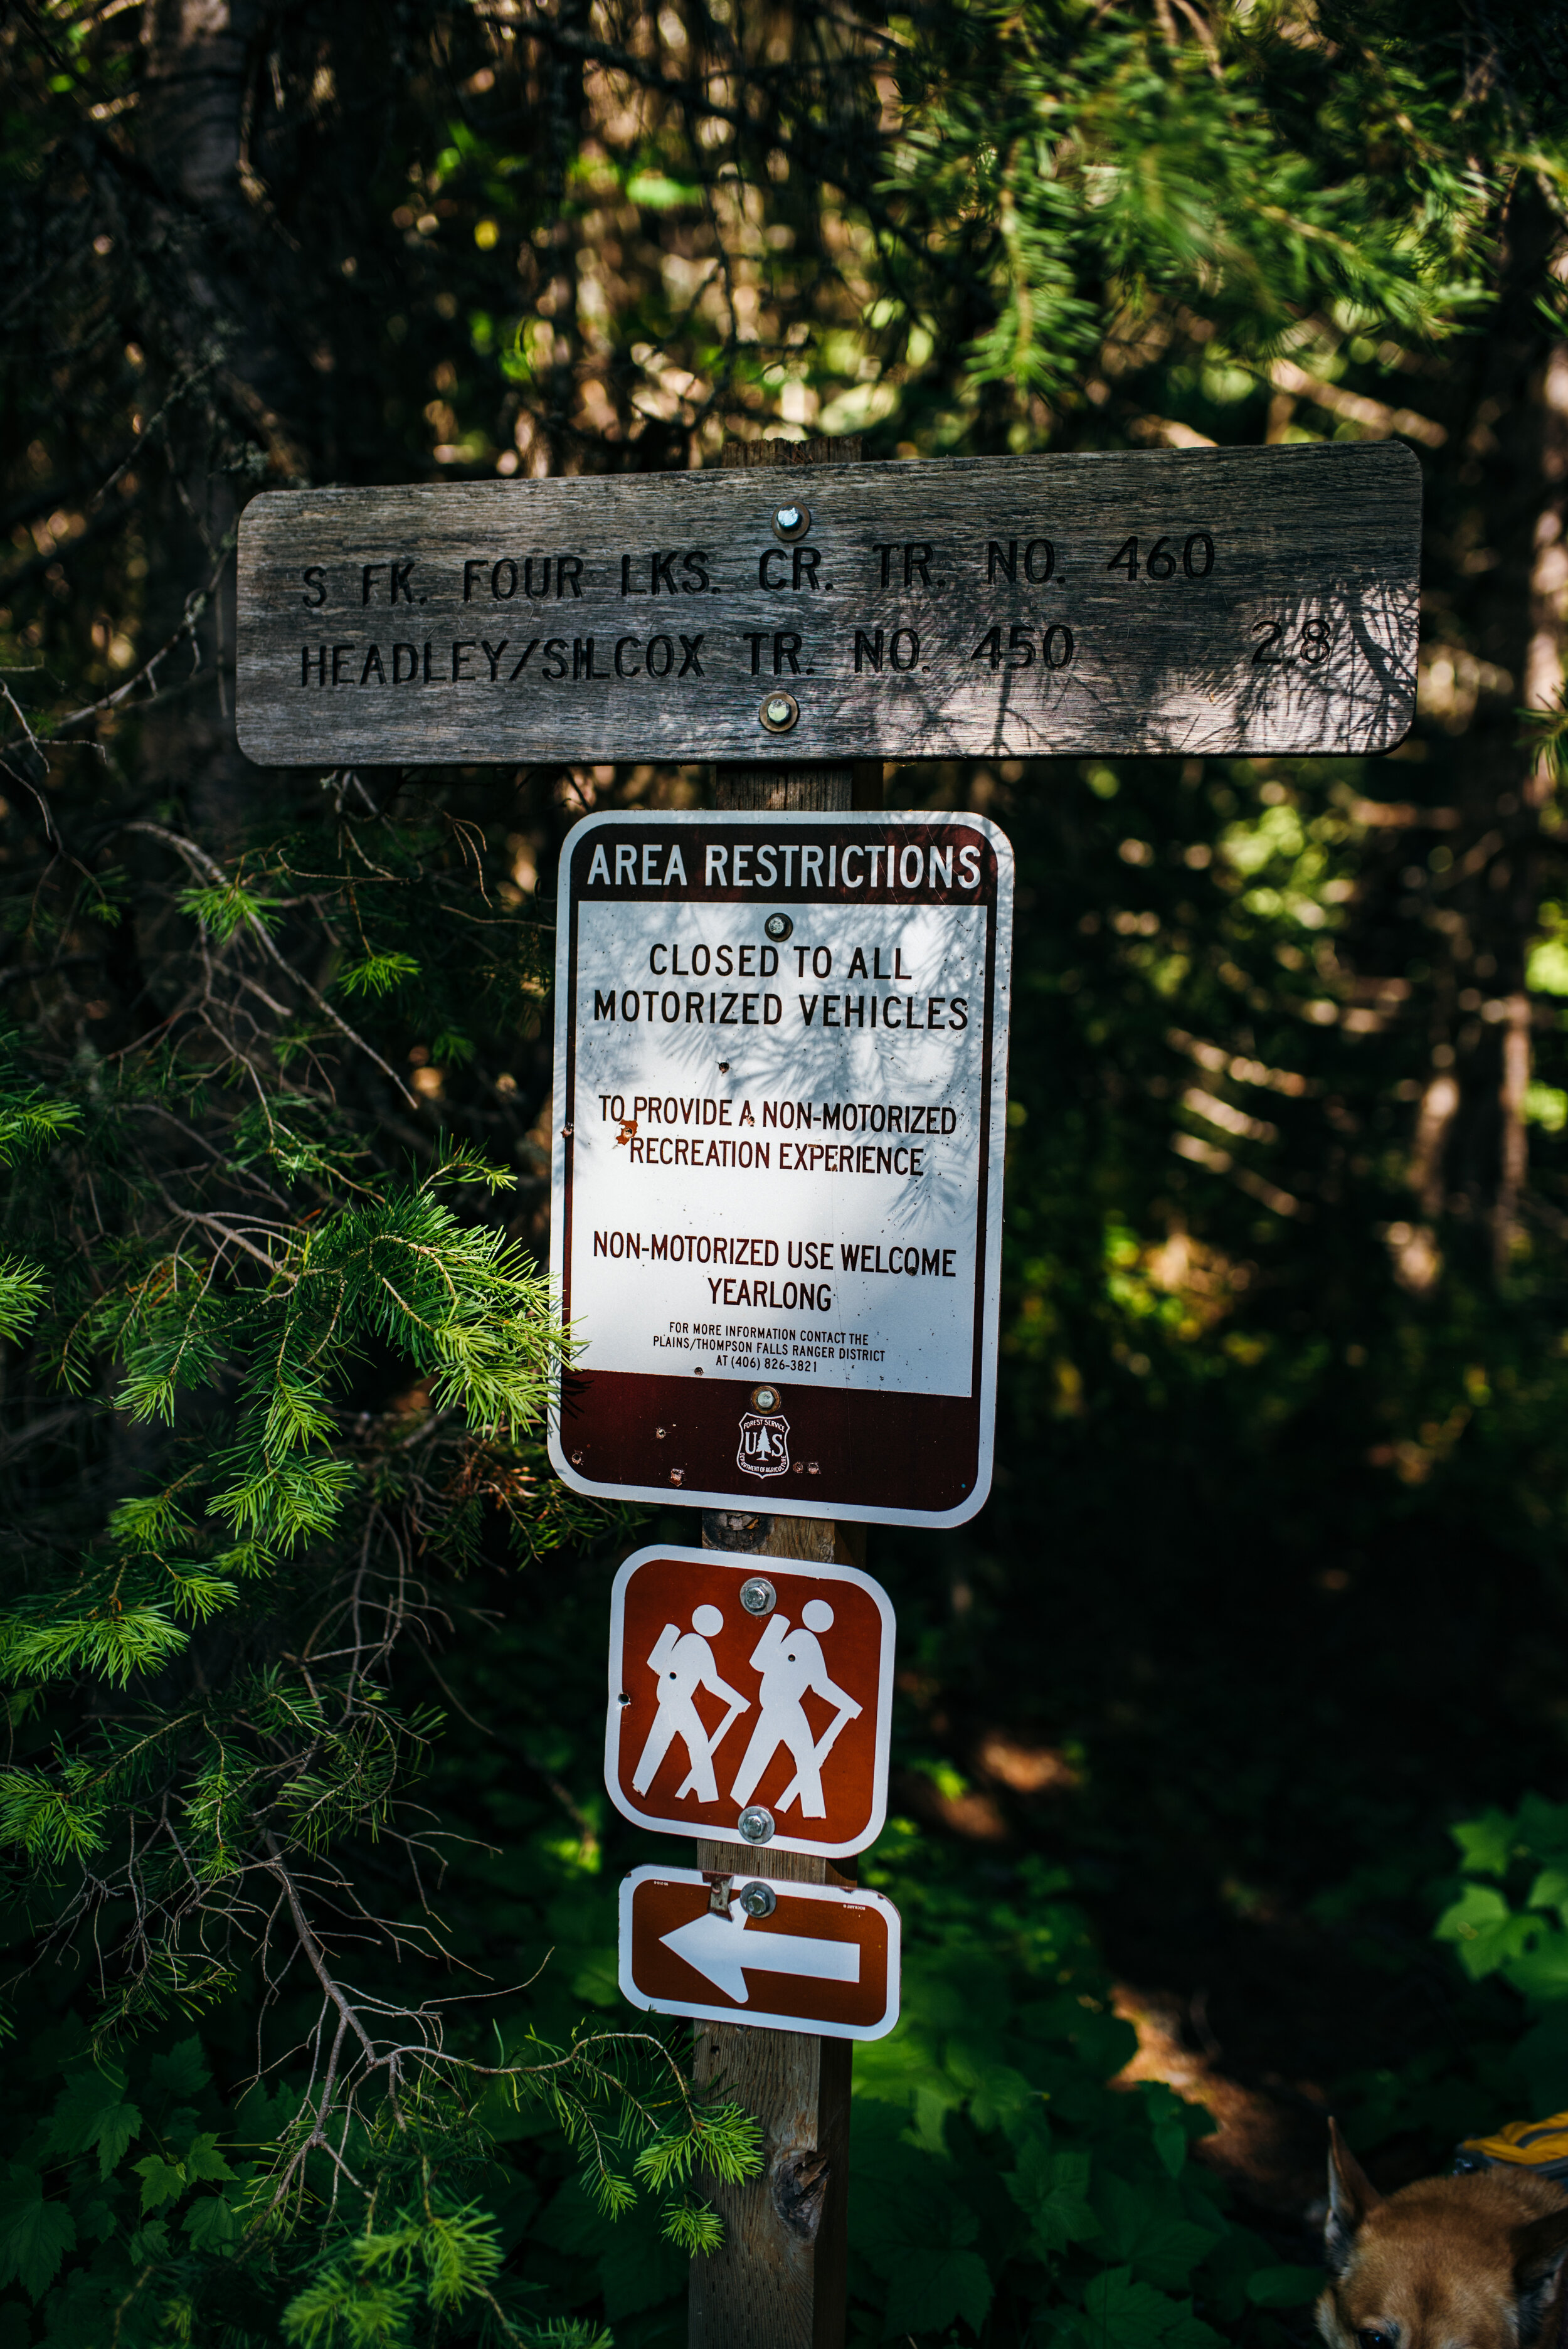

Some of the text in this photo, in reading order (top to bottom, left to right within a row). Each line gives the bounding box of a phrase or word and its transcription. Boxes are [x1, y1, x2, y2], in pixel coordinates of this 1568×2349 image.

[302, 533, 1216, 608] S FK. FOUR LKS. CR. TR. NO. 460
[301, 618, 1331, 687] HEADLEY/SILCOX TR. NO. 450 2.8
[588, 843, 982, 889] AREA RESTRICTIONS
[649, 943, 913, 980] CLOSED TO ALL
[593, 989, 969, 1031] MOTORIZED VEHICLES
[598, 1095, 956, 1135] TO PROVIDE A NON-MOTORIZED
[629, 1137, 924, 1176] RECREATION EXPERIENCE
[593, 1231, 956, 1278] NON-MOTORIZED USE WELCOME
[707, 1277, 832, 1312] YEARLONG
[653, 1335, 886, 1362] PLAINS/THOMPSON FALLS RANGER DISTRICT
[669, 1321, 869, 1346] FOR MORE INFORMATION CONTACT THE
[716, 1354, 817, 1373] AT (406) 826-3821
[744, 1419, 785, 1433] FOREST SERVICE
[745, 1432, 783, 1456] U S
[740, 1453, 760, 1471] DEPARTMENT
[765, 1455, 787, 1473] AGRICULTURE
